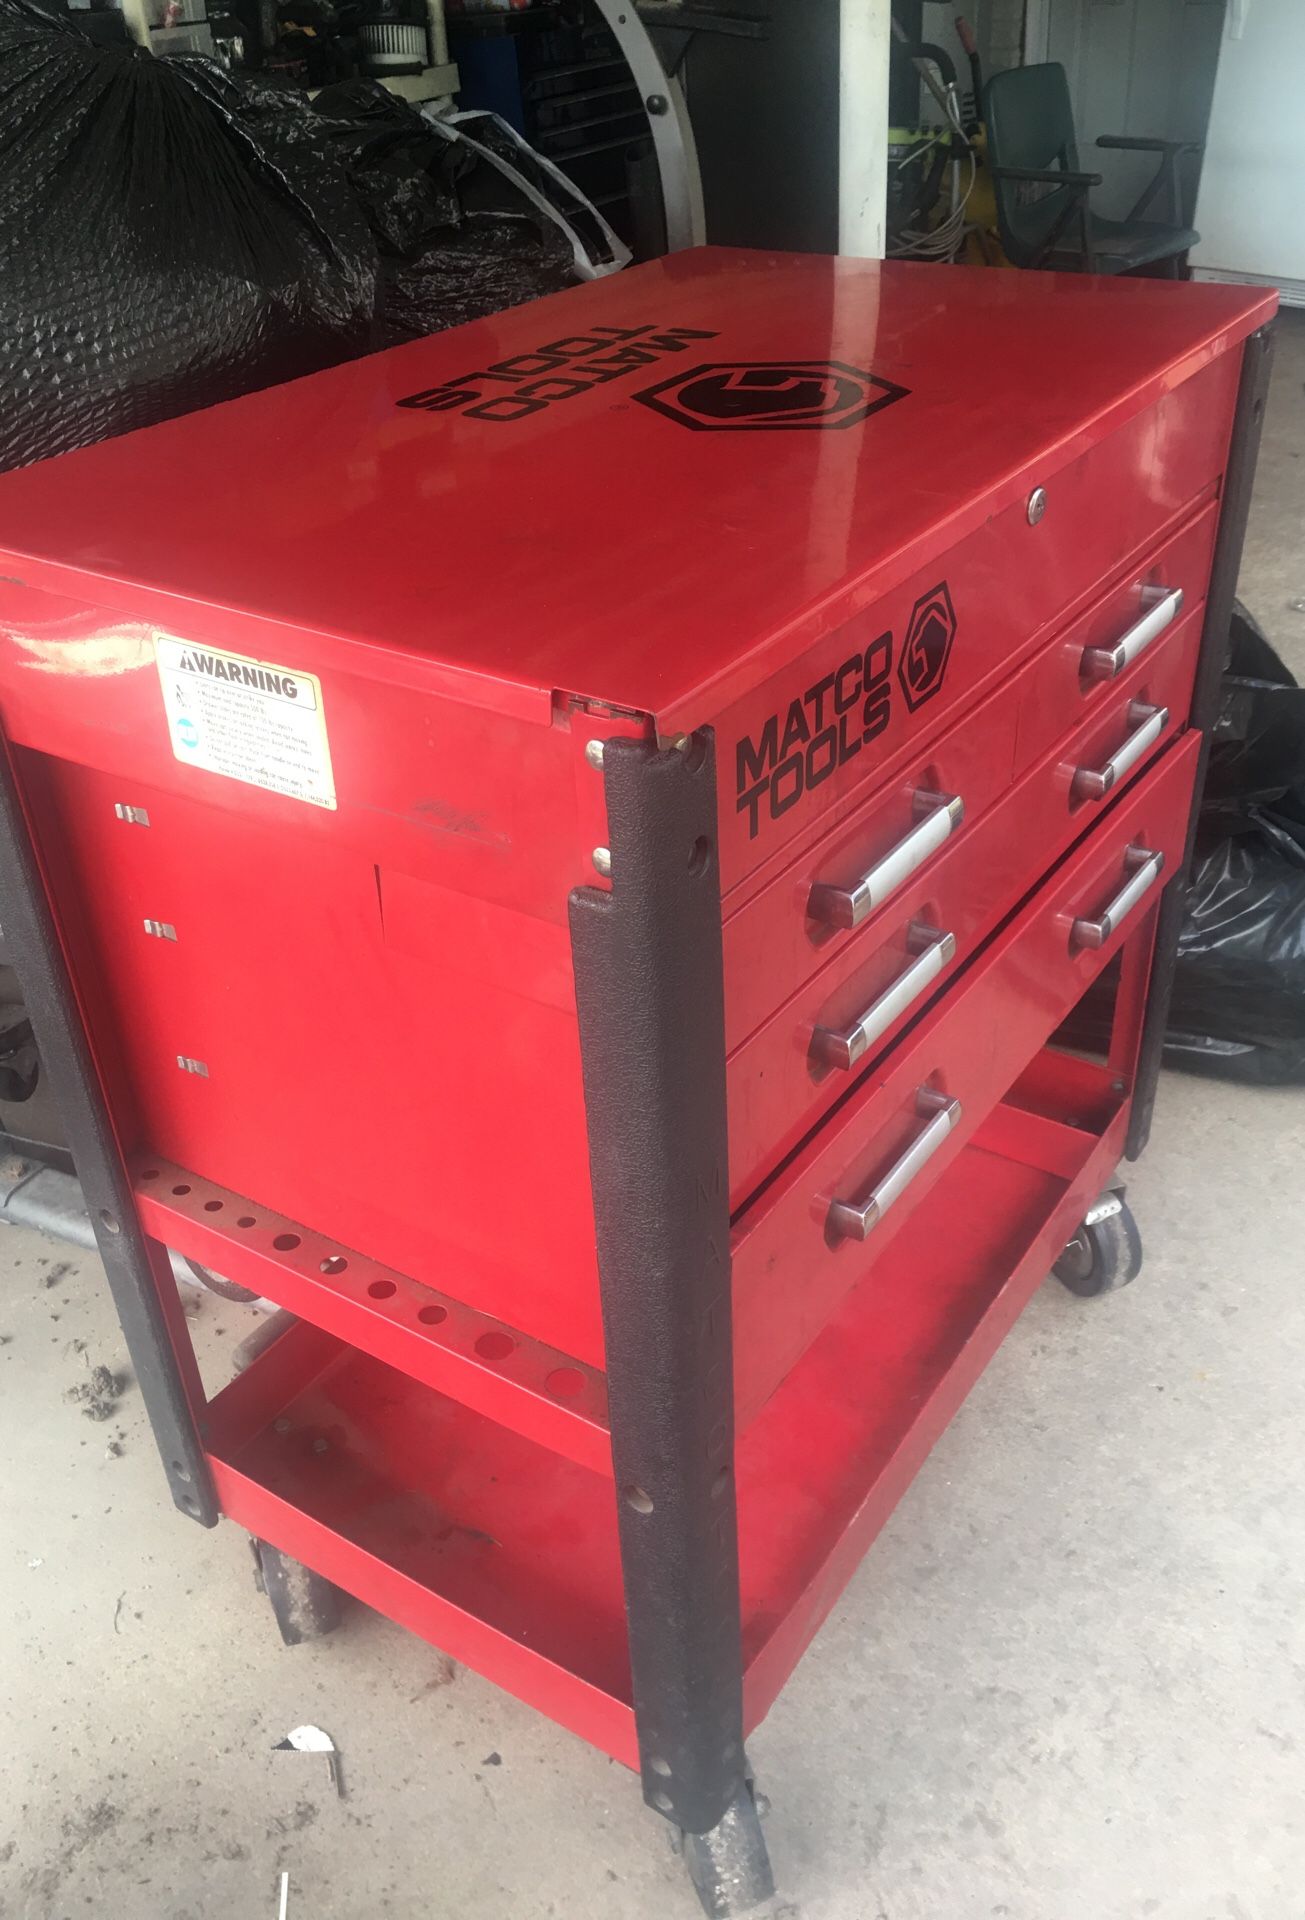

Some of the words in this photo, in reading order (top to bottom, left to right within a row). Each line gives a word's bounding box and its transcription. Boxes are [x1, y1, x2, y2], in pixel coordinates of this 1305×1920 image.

[395, 325, 660, 411] TOOLS
[462, 327, 722, 422] MATCO
[192, 651, 298, 699] WARNING
[736, 630, 893, 795] MATCO
[736, 681, 891, 840] TOOLS
